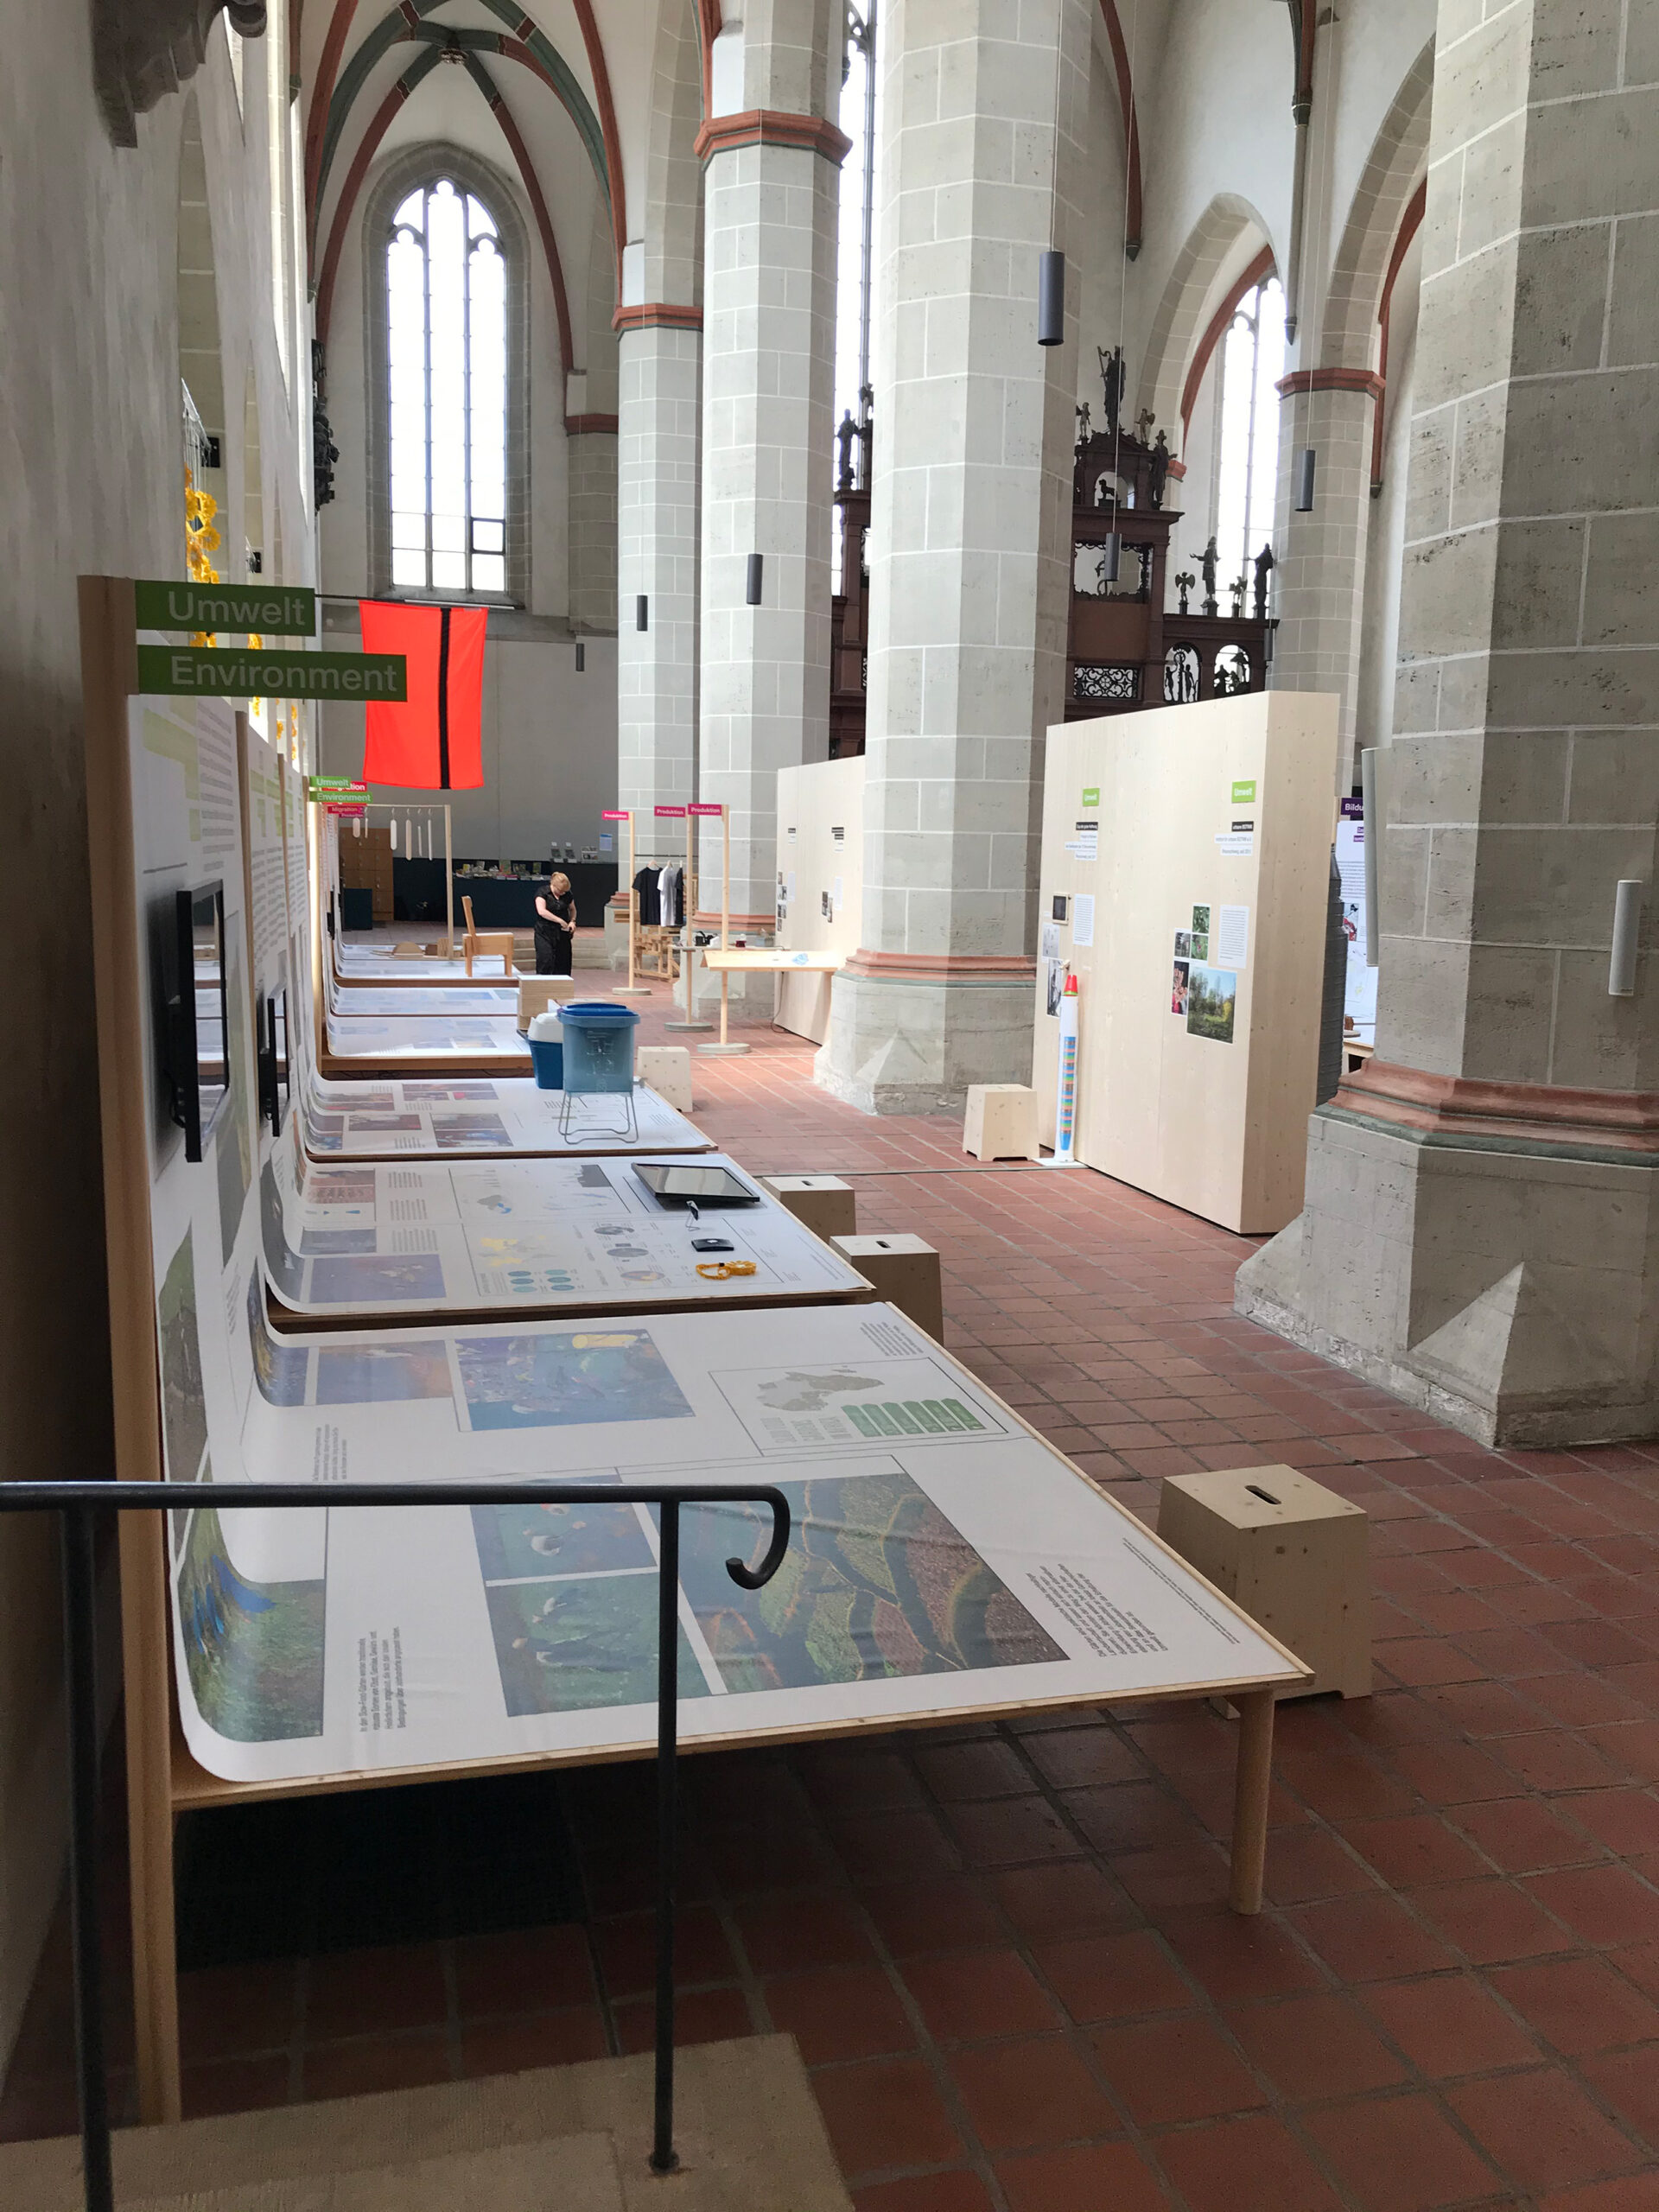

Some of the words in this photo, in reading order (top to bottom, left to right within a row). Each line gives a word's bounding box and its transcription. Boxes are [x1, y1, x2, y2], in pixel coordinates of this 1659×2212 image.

[168, 590, 305, 626] Umwelt
[171, 655, 397, 692] Environment
[316, 778, 348, 786] Umwelt
[317, 792, 371, 802] Environment
